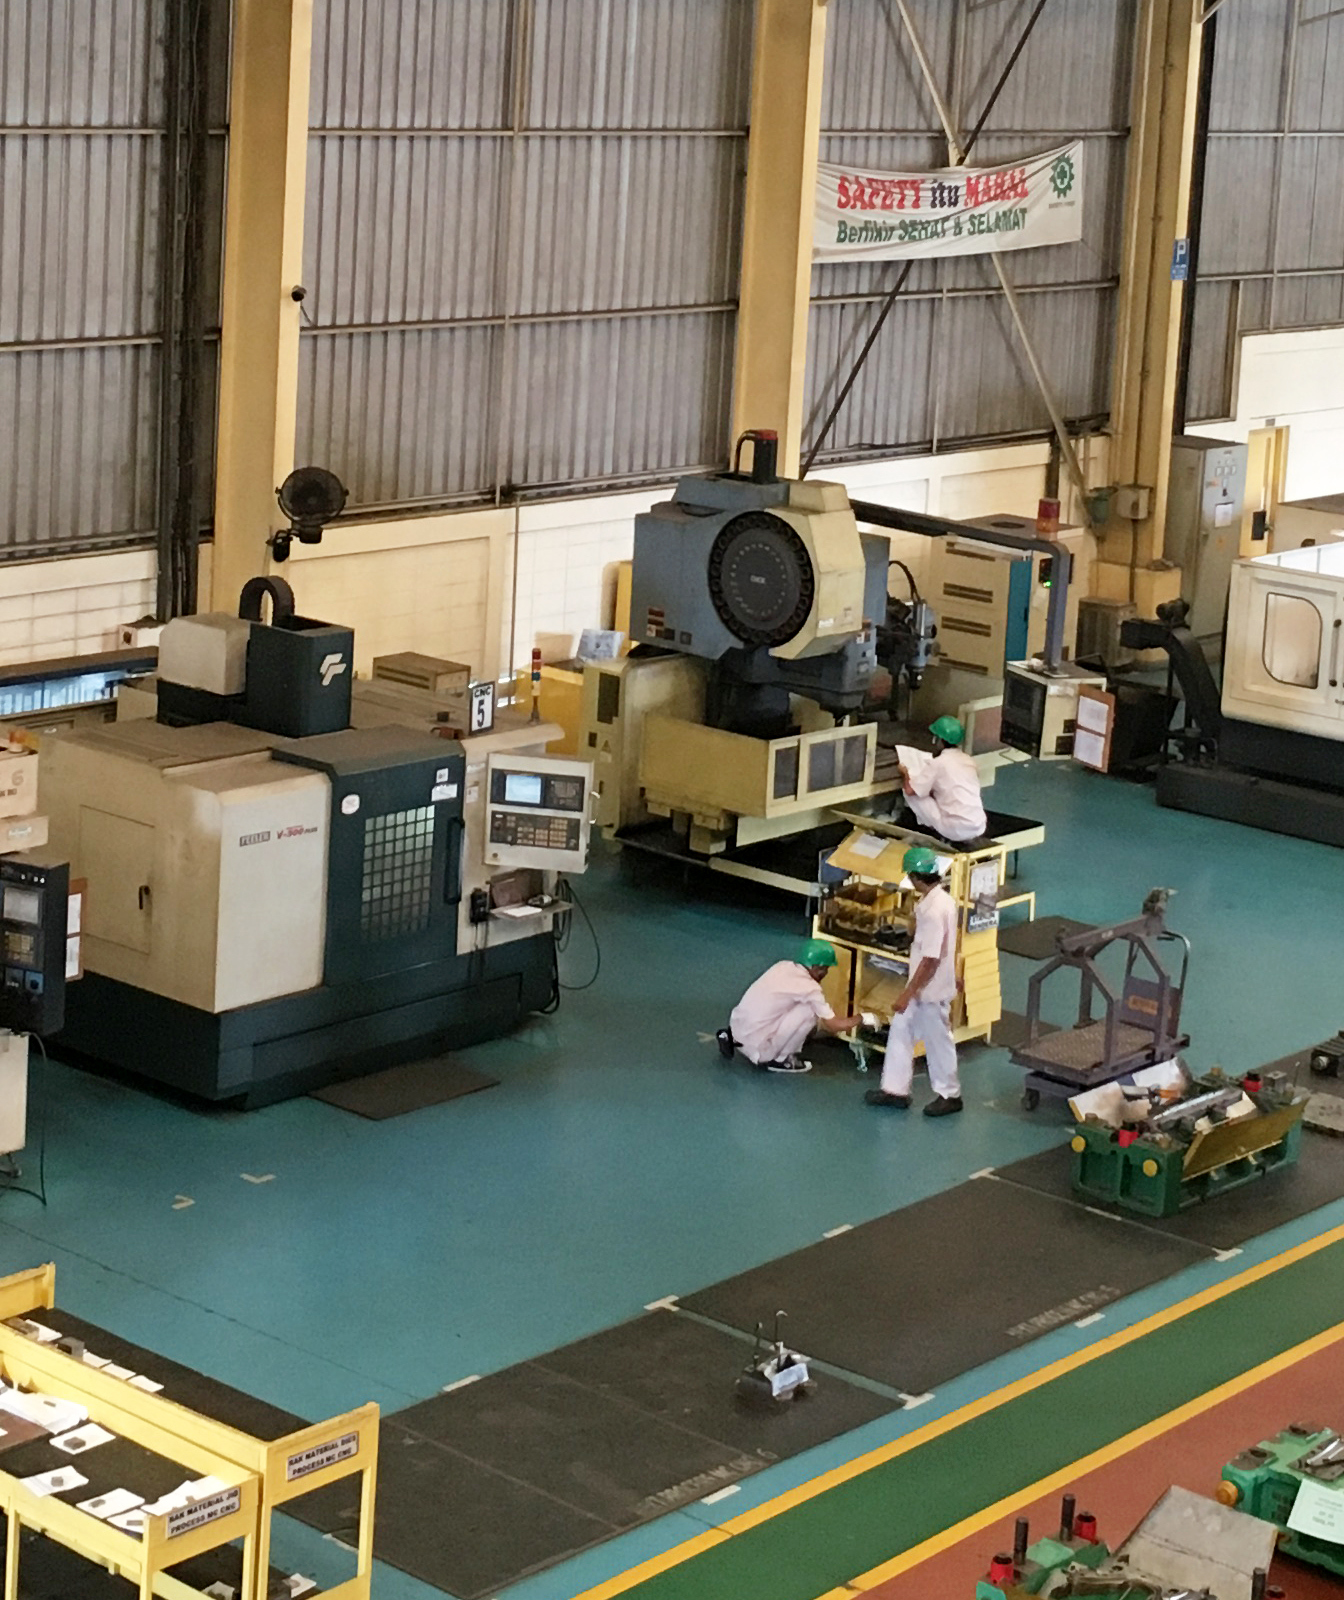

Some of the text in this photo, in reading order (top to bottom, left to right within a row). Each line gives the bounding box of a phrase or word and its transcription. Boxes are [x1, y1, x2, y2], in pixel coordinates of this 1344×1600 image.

[837, 168, 1029, 210] SAFETY itu MAHAL
[836, 220, 895, 243] Berfikir
[898, 217, 950, 241] SEHAT
[967, 208, 1027, 235] SELAMAT
[1176, 241, 1186, 262] P
[474, 686, 491, 698] CNC
[477, 699, 485, 727] 5
[305, 1443, 338, 1460] MATERIAL
[293, 1458, 324, 1475] PROCESS
[187, 1496, 224, 1515] MATERIAL
[171, 1515, 205, 1534] PROCESS
